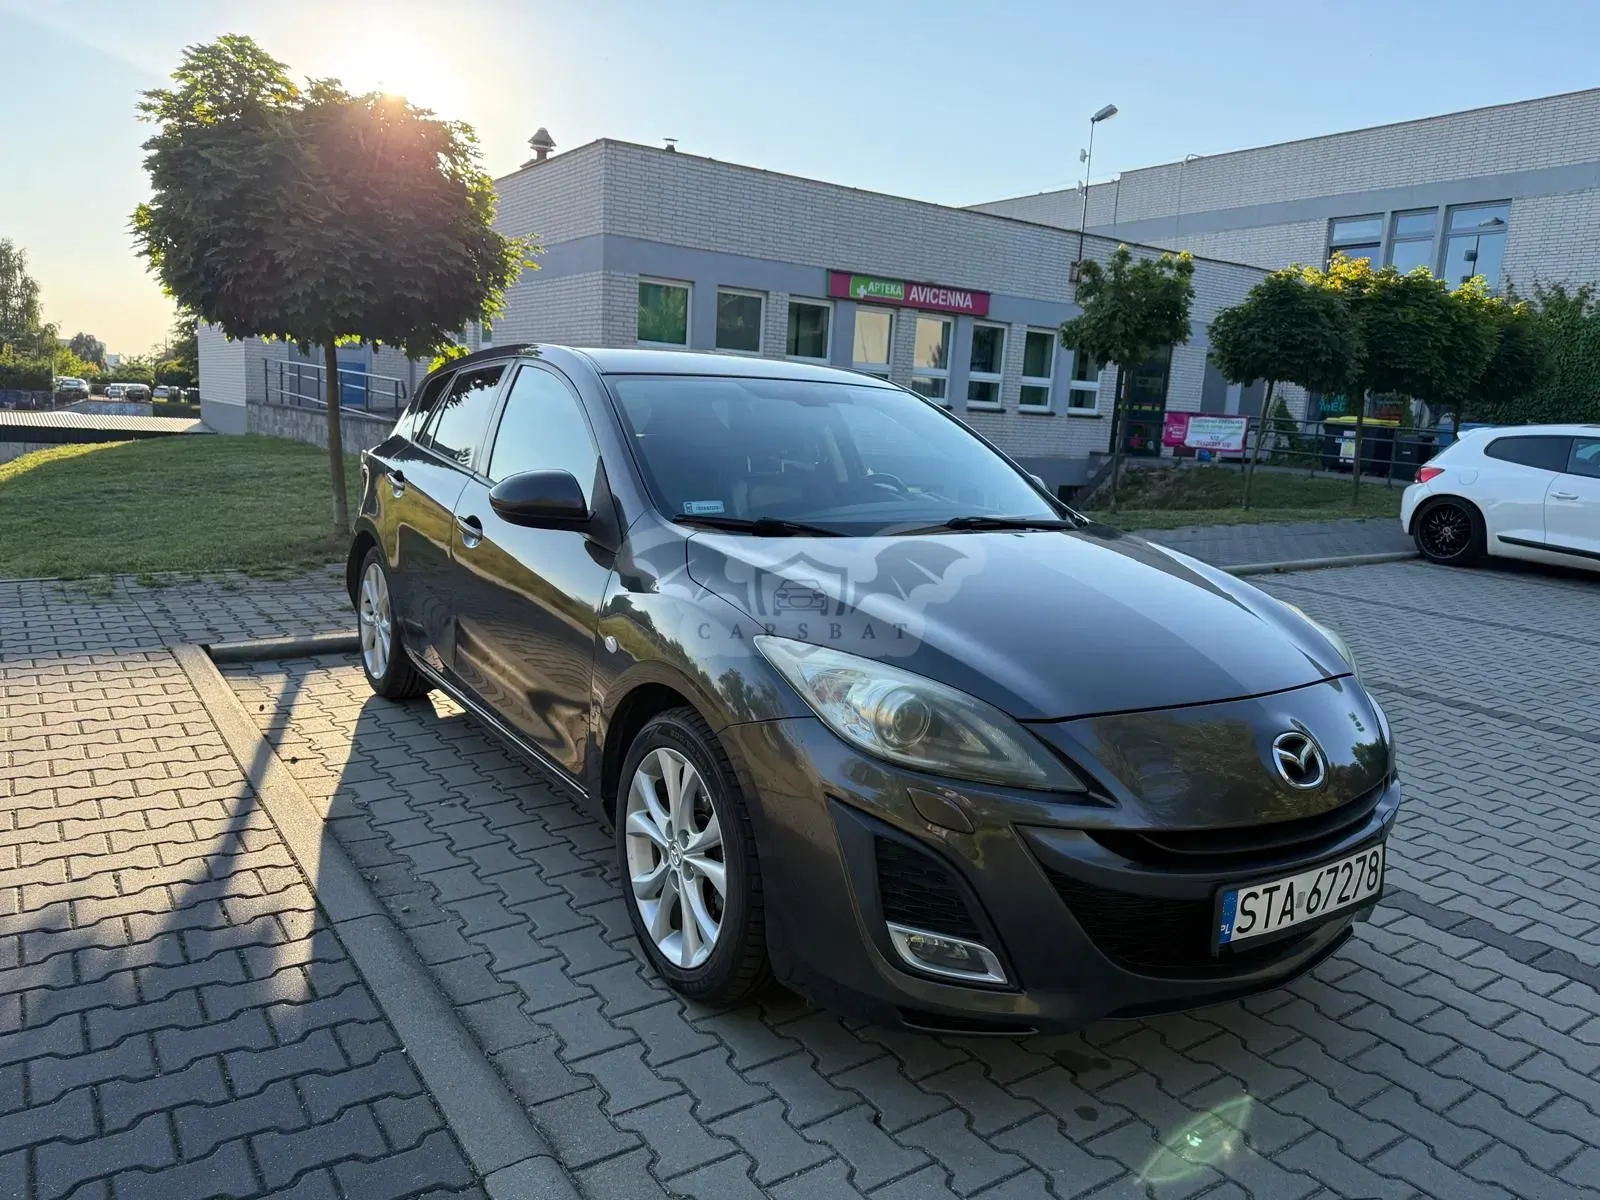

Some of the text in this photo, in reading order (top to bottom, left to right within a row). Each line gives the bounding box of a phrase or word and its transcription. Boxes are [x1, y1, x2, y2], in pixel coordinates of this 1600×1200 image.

[868, 280, 902, 296] APTEKA
[909, 285, 973, 309] AVICENNA
[1235, 850, 1380, 934] STA 67278
